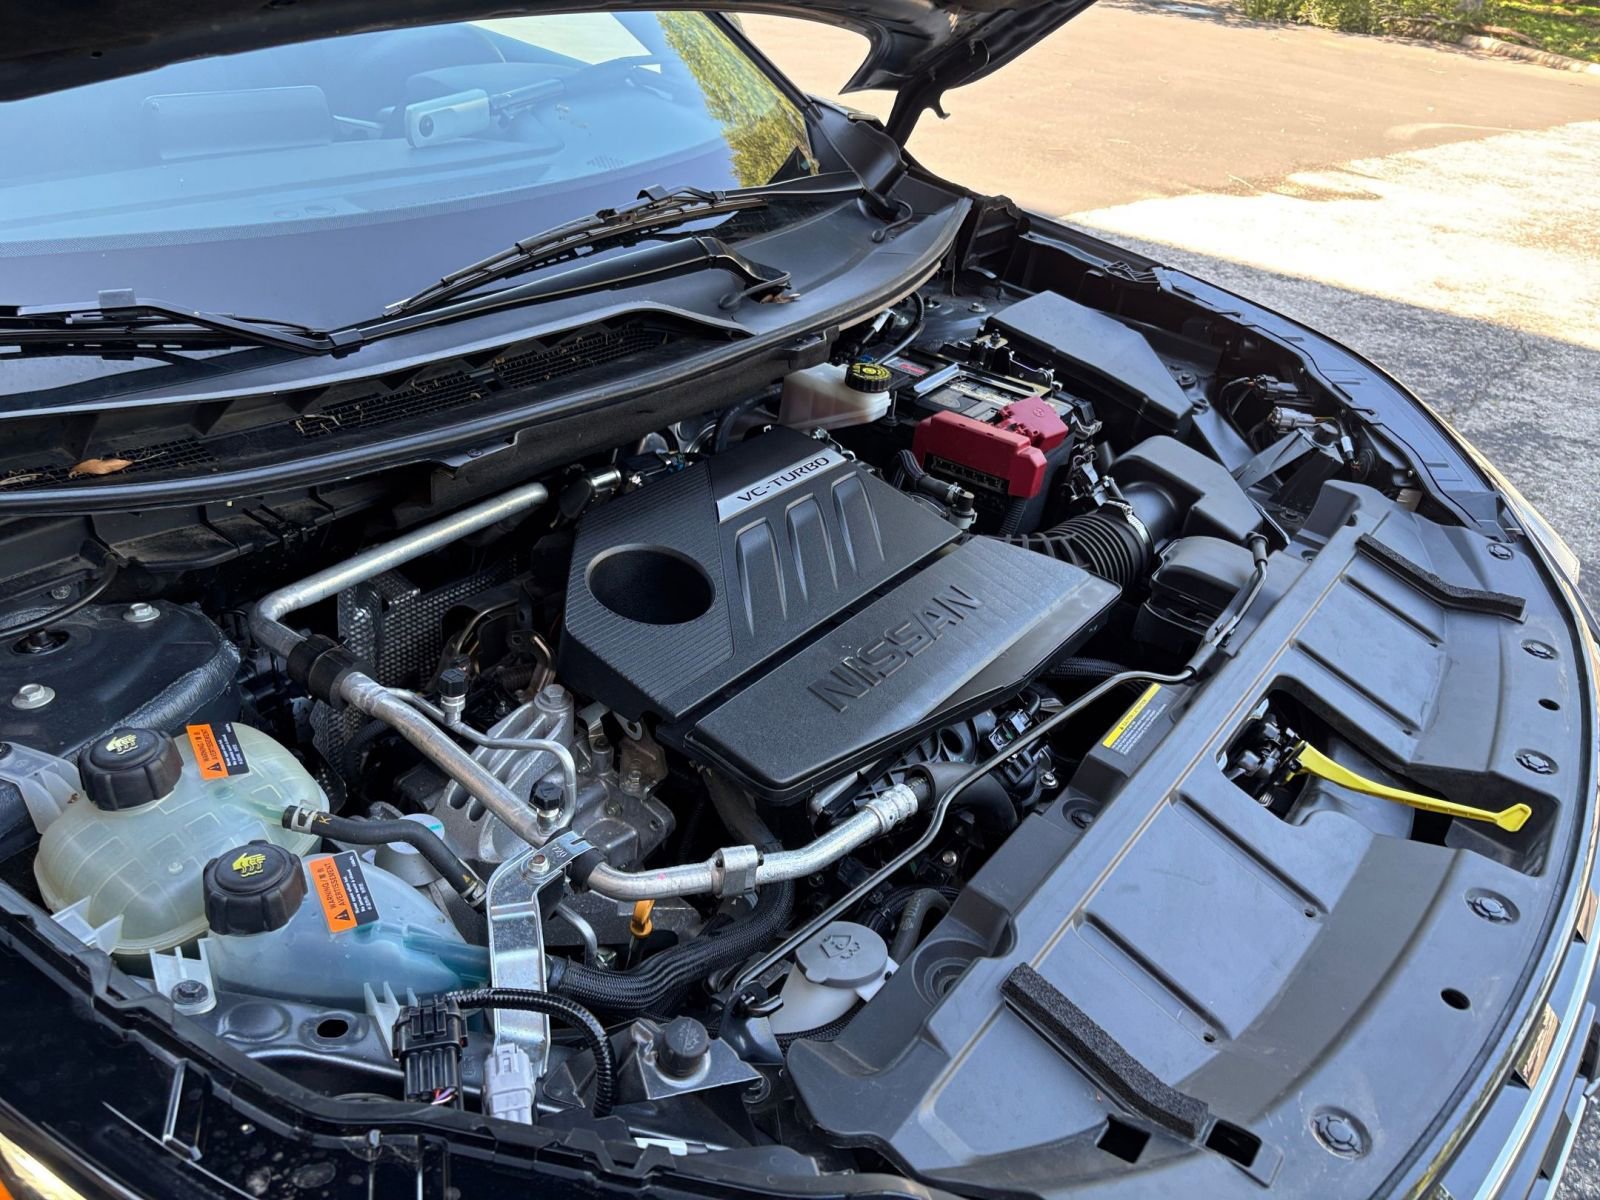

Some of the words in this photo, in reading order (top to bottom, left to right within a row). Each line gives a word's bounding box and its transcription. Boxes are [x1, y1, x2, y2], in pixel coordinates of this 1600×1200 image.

[736, 457, 830, 502] VC-TURBO
[807, 584, 982, 711] NISSAN
[322, 882, 337, 910] WARNING
[324, 862, 346, 907] AVERTISSEMENT
